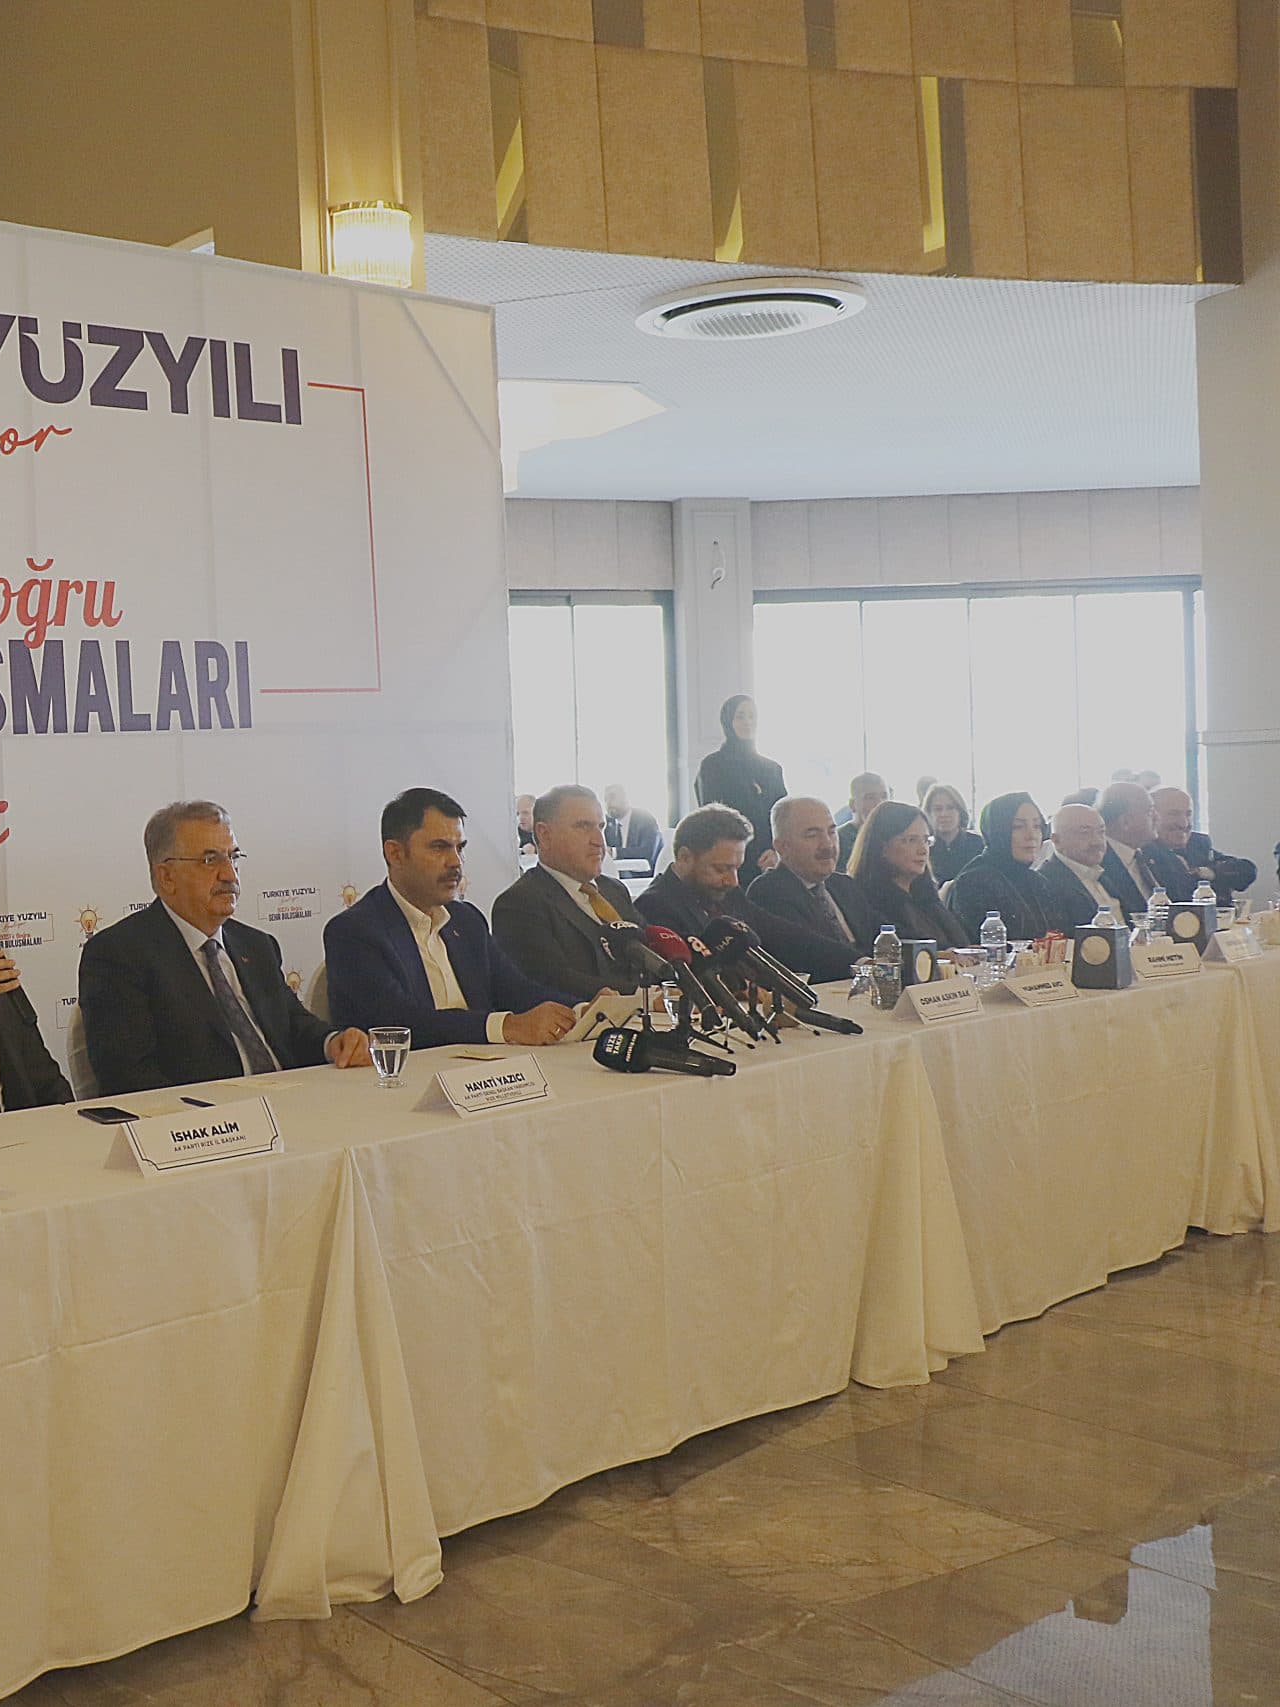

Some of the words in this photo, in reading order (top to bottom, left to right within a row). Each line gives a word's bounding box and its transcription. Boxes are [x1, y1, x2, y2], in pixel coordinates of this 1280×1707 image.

[464, 1076, 497, 1092] HAYATİ
[496, 1073, 525, 1086] YAZICI
[170, 1127, 209, 1143] İSHAK
[211, 1121, 240, 1137] ALİM
